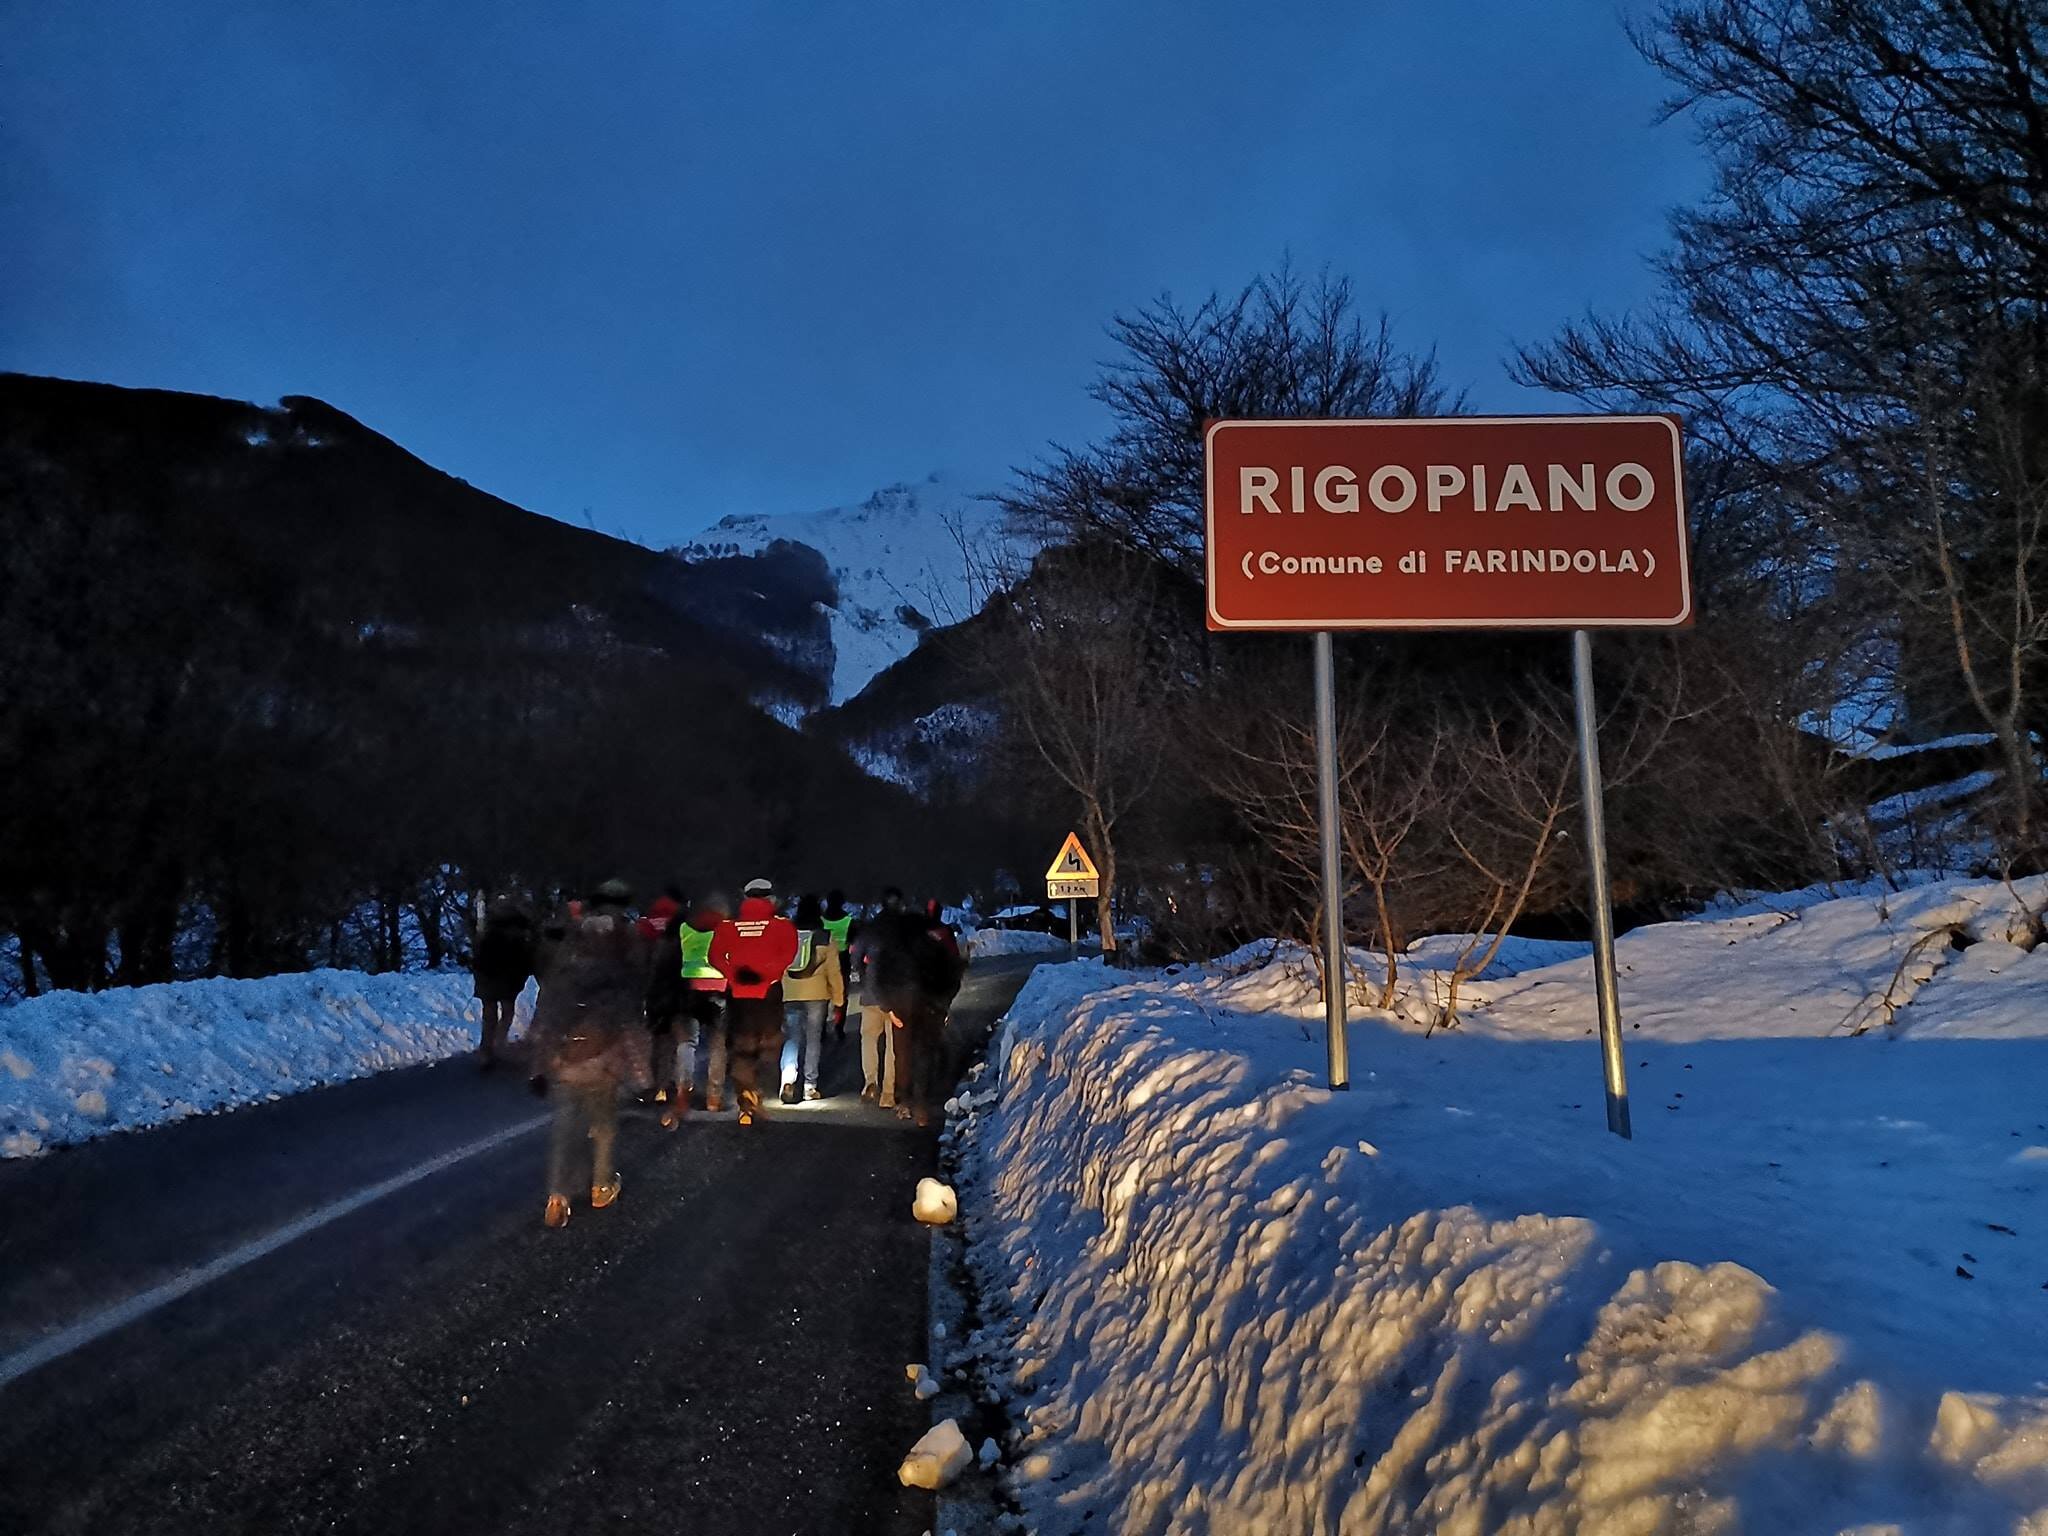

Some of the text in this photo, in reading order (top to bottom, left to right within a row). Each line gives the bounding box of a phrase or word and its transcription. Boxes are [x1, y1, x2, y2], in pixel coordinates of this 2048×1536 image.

[1239, 462, 1656, 514] RIGOPIANO
[1241, 549, 1656, 579] (Comune di FARINDOLA)
